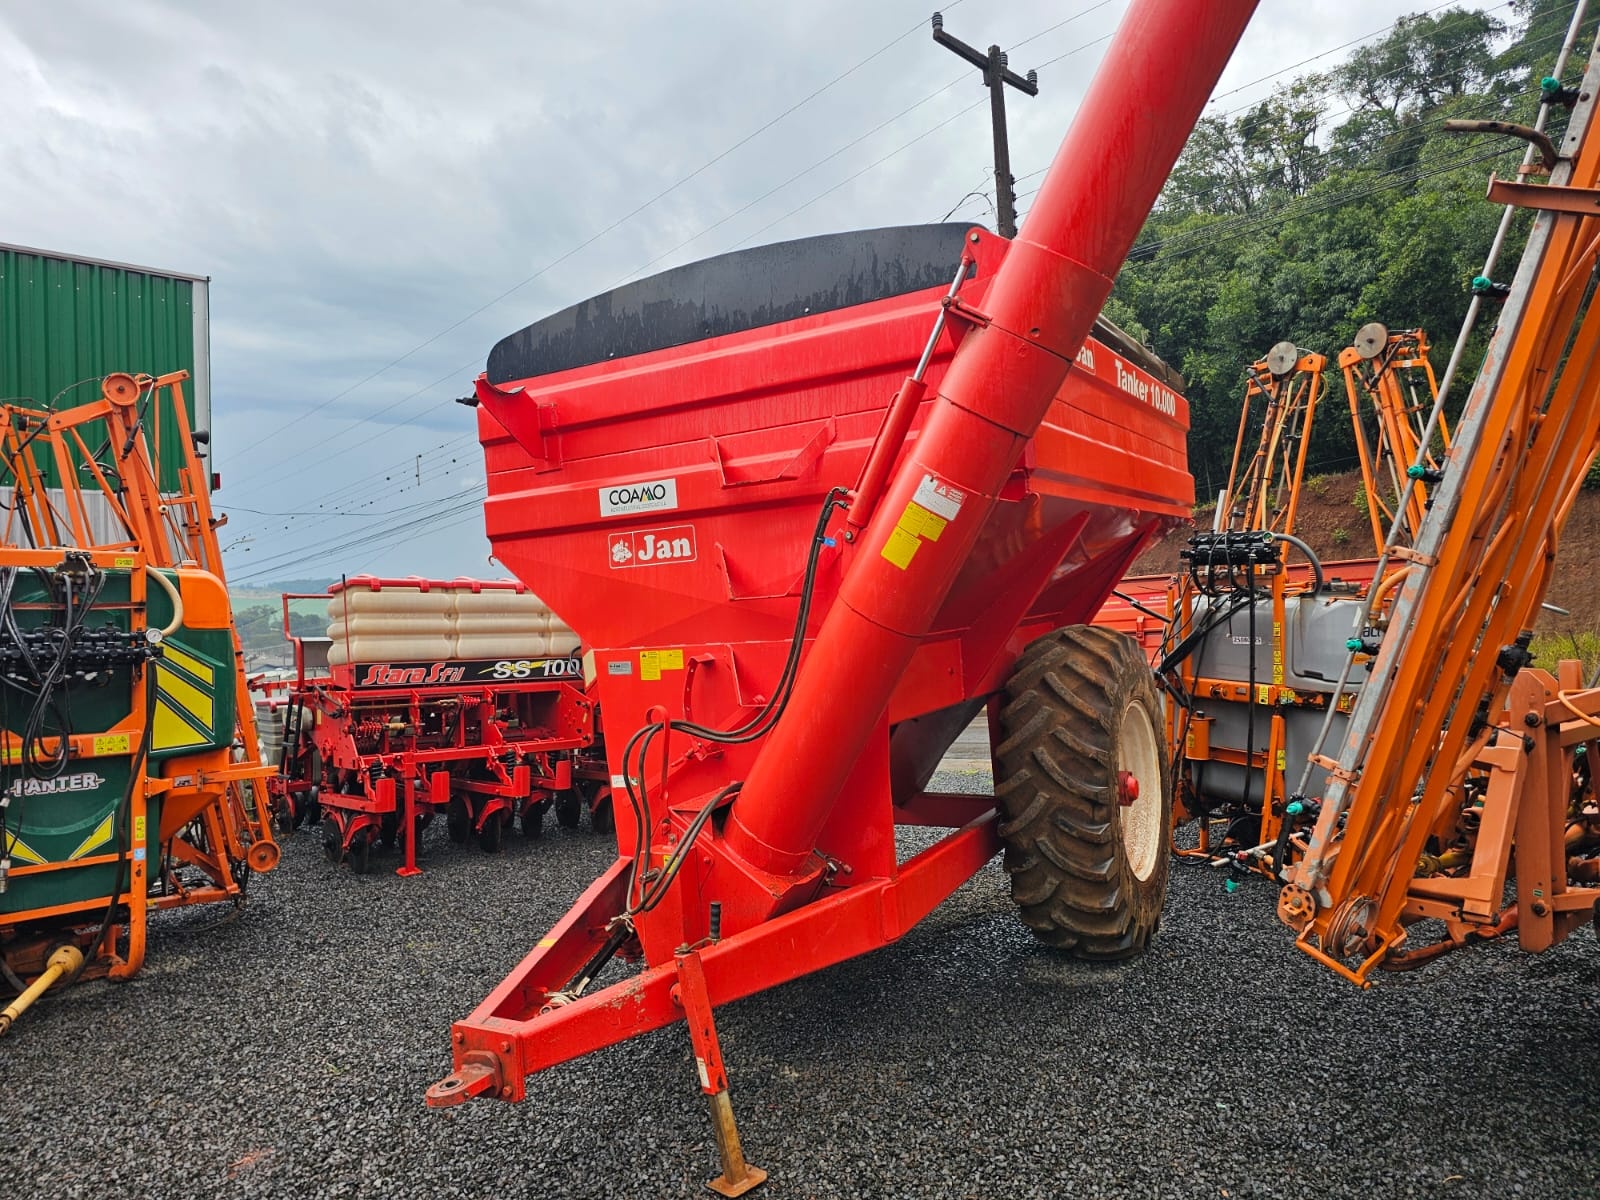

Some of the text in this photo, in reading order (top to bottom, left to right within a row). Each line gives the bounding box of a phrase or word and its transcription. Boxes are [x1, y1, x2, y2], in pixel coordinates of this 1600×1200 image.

[1076, 345, 1094, 369] an
[1115, 359, 1176, 417] Tanker 10.000
[609, 484, 666, 505] COAMO
[638, 534, 692, 561] Jan
[361, 664, 427, 686] Stara
[424, 662, 466, 683] Sfil
[492, 660, 531, 679] SS
[15, 773, 99, 797] PANTER
